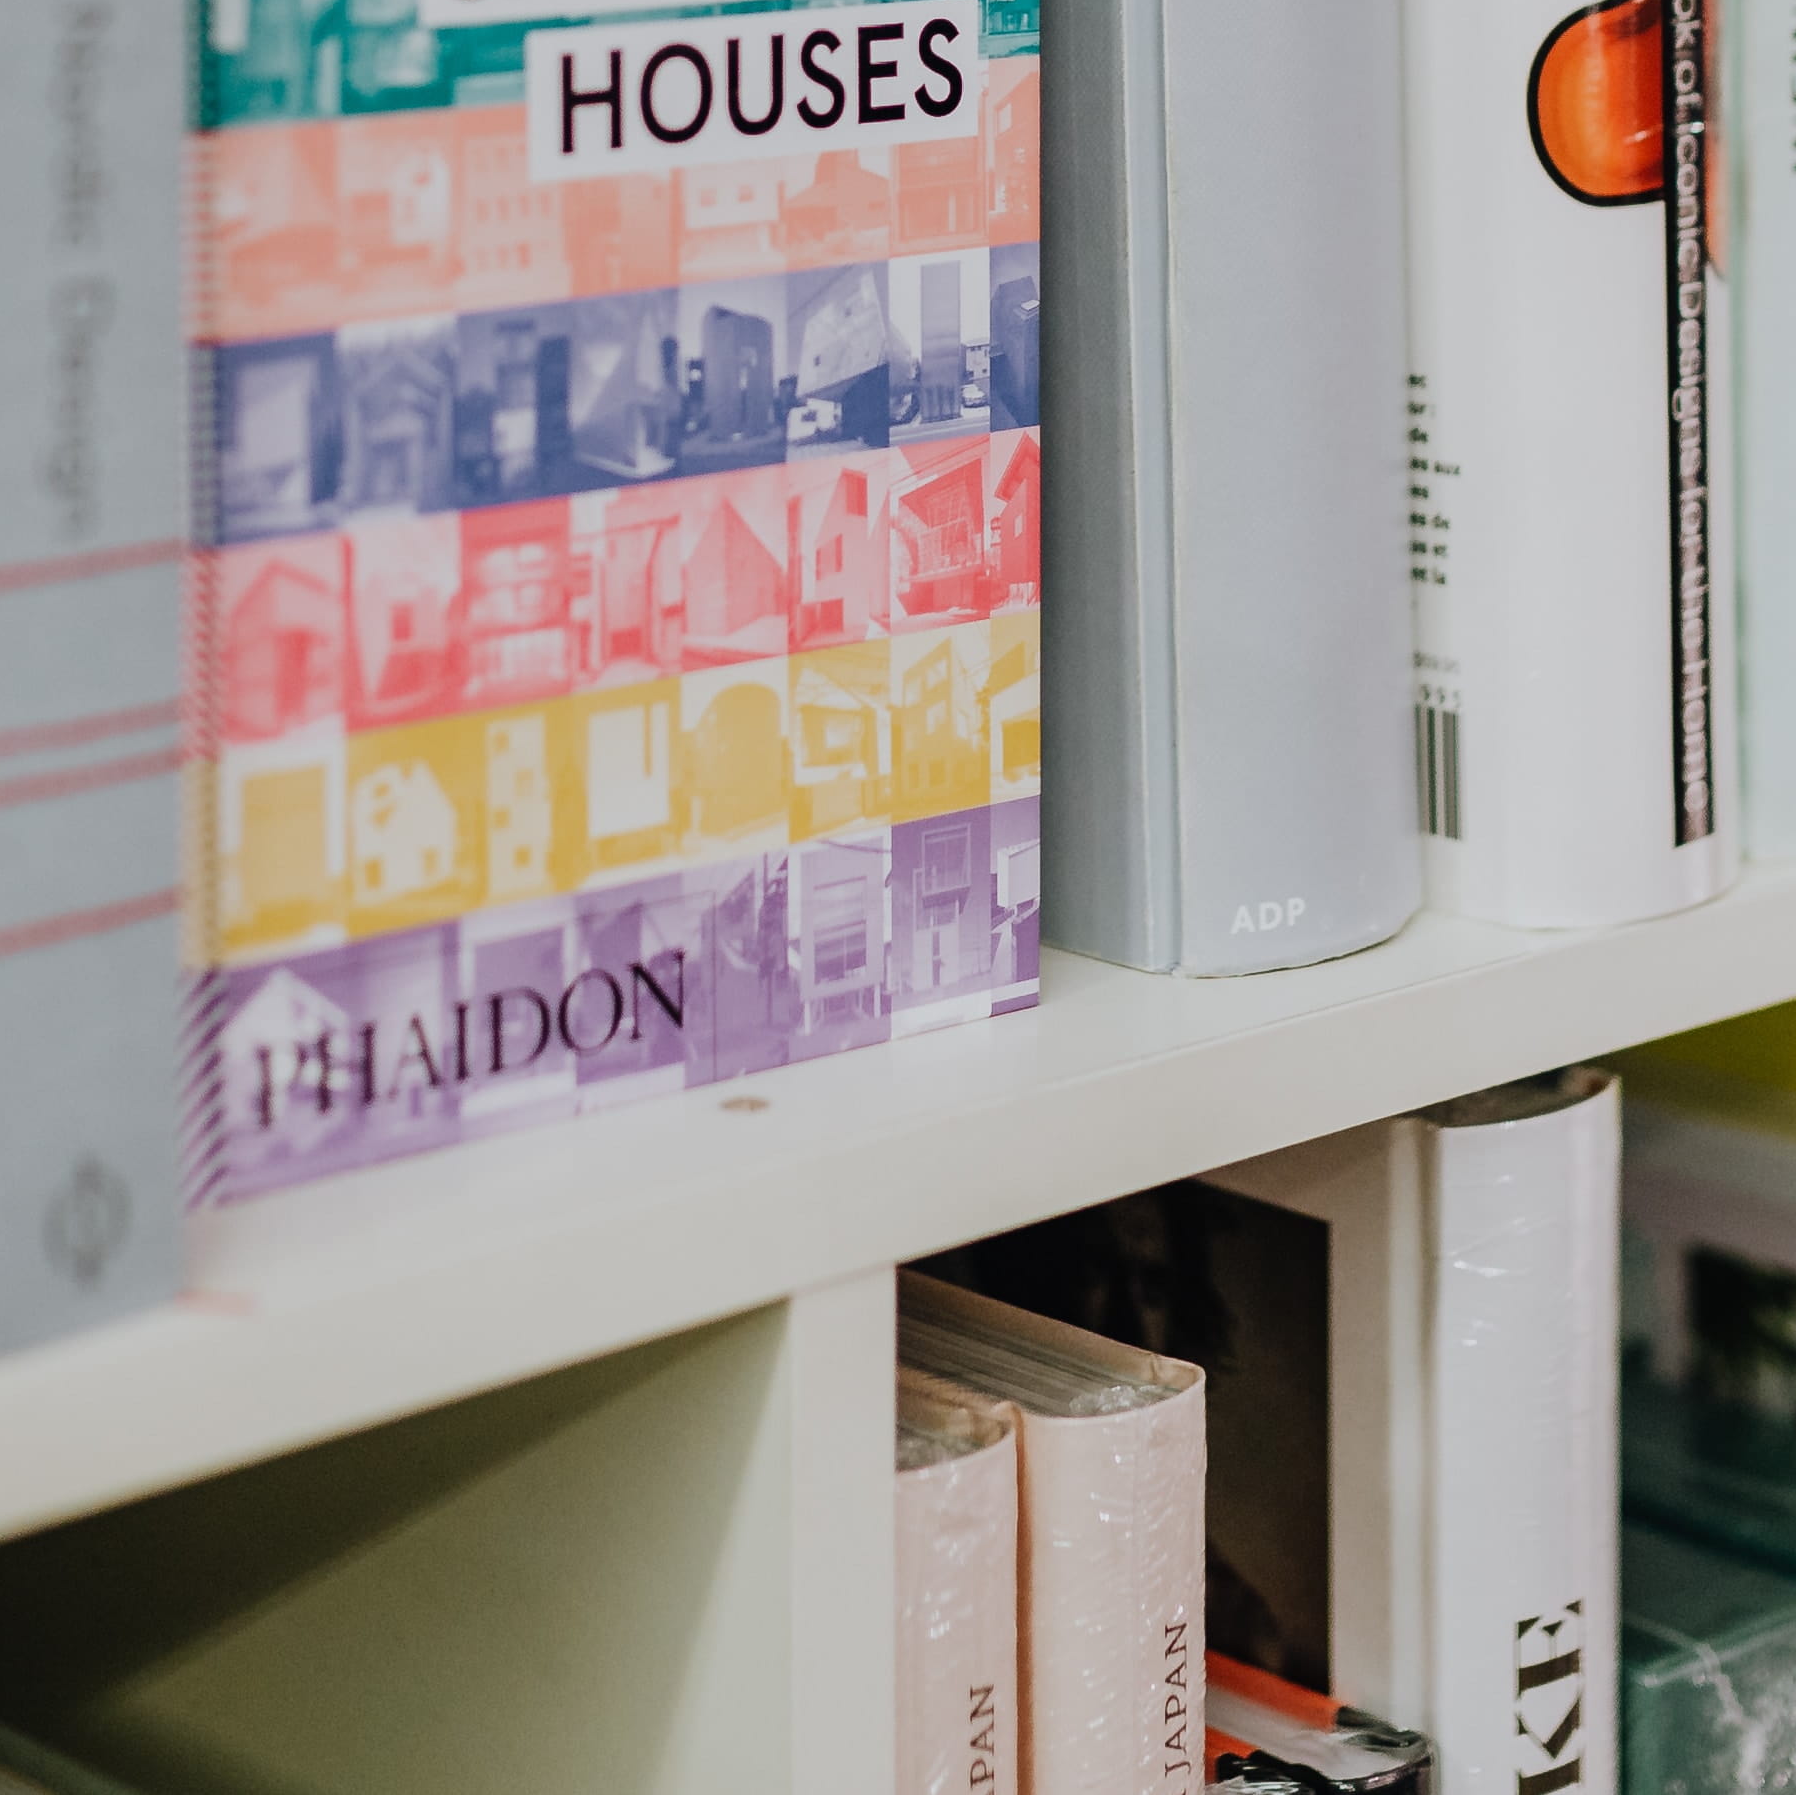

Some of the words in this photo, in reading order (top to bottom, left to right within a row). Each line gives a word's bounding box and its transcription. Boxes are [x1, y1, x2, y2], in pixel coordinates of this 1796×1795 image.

[559, 17, 965, 155] HOUSES
[1673, 57, 1702, 111] of
[1675, 118, 1703, 270] Iconic
[1671, 280, 1705, 476] Designs
[1680, 485, 1707, 547] for
[1681, 565, 1708, 652] the
[1681, 660, 1710, 813] Home
[1229, 896, 1307, 936] ADP
[255, 948, 691, 1130] PHAIDON
[969, 1684, 995, 1795] PAN
[1164, 1622, 1192, 1779] JAPAN
[1516, 1599, 1582, 1795] KE
